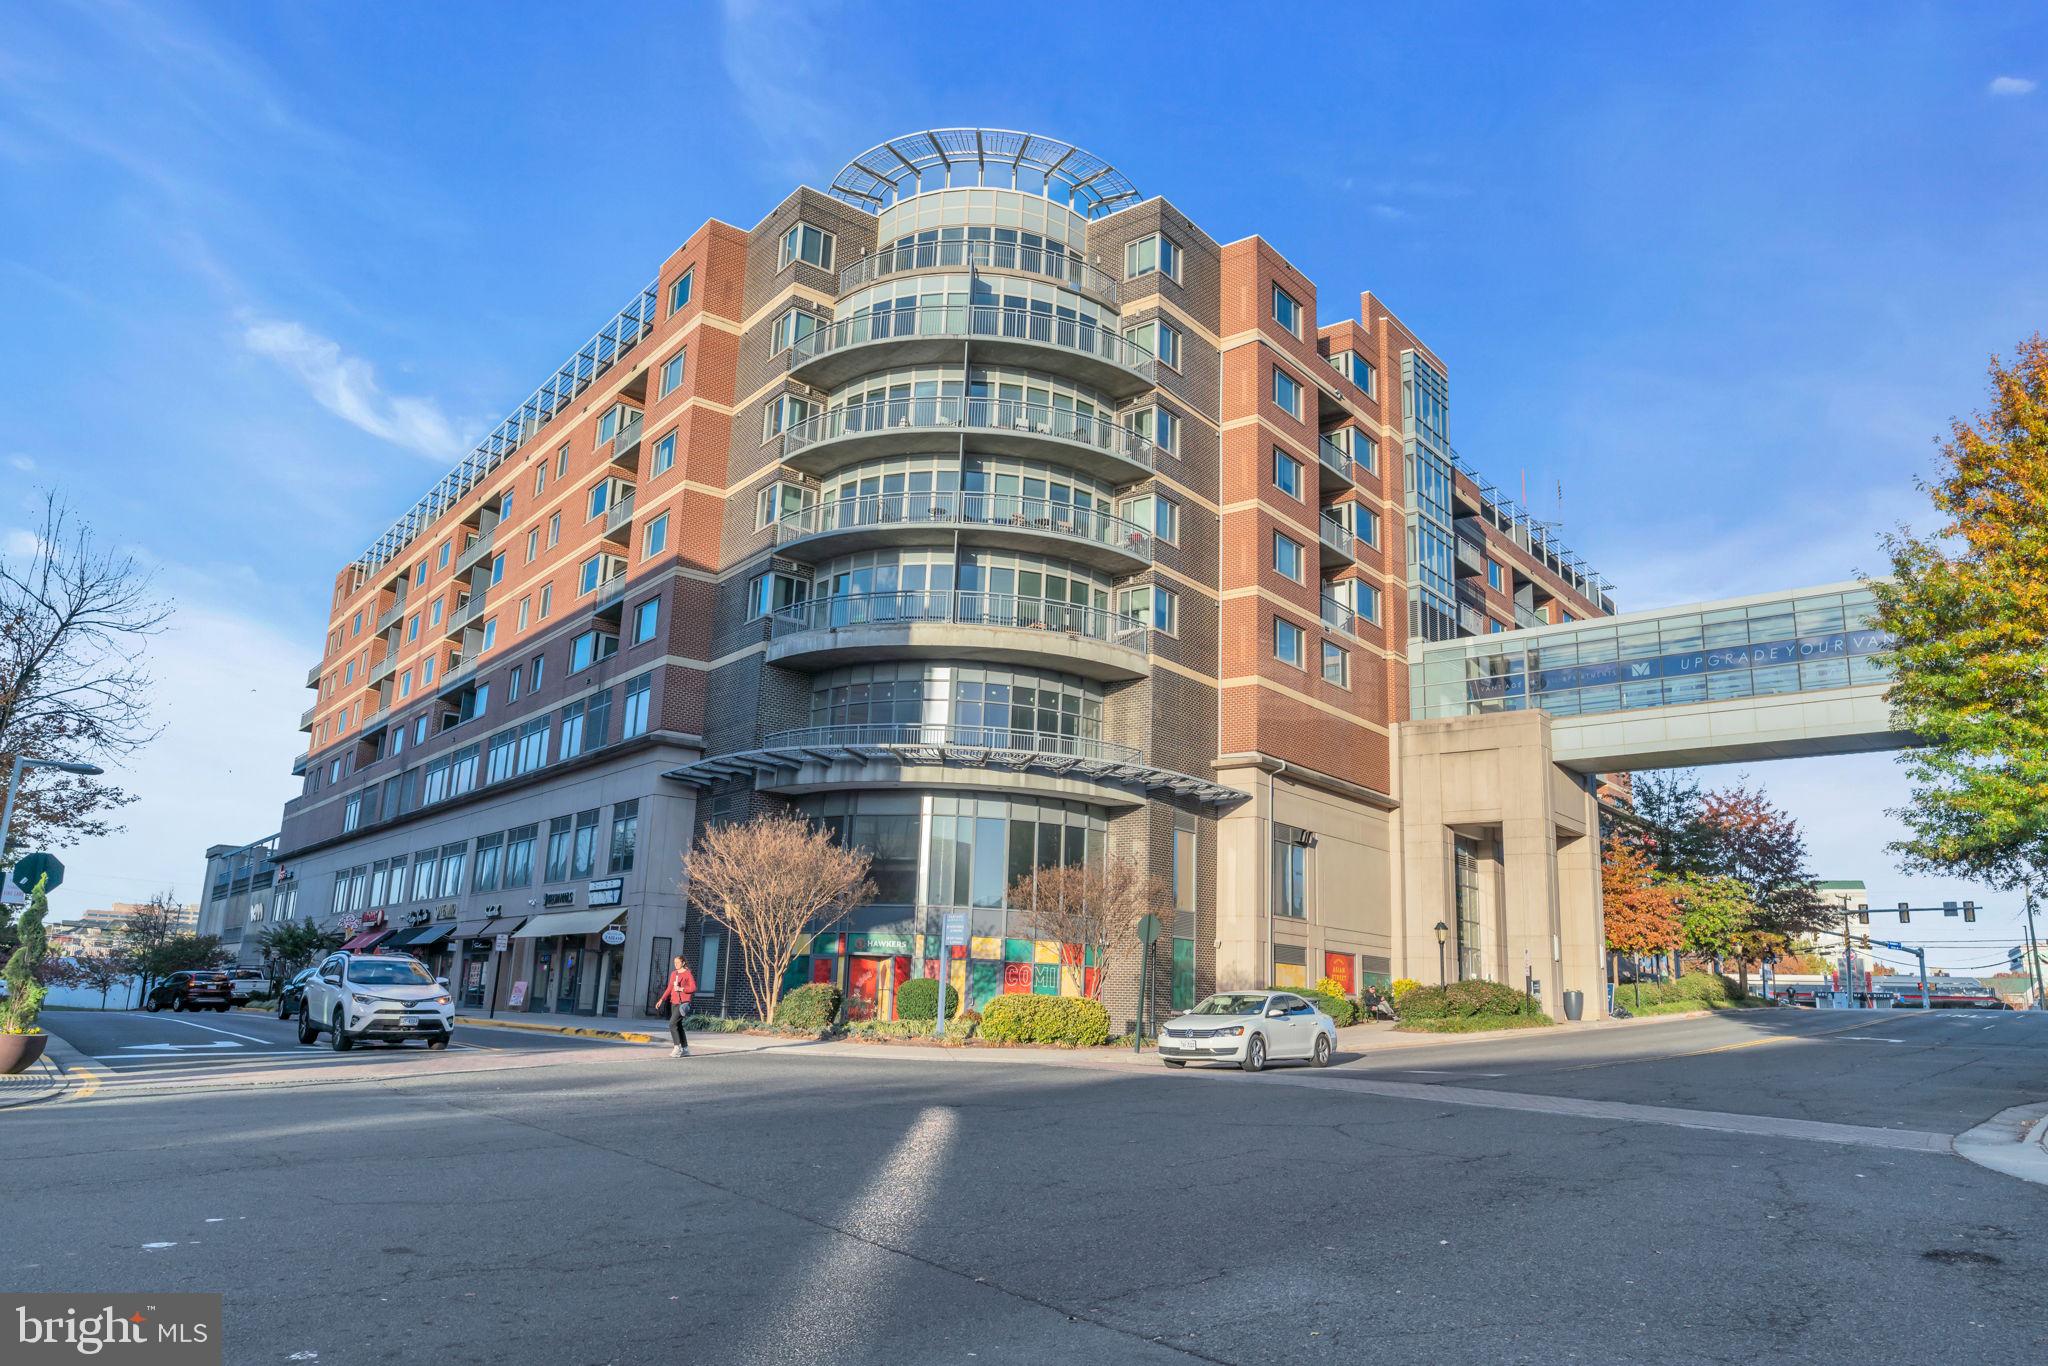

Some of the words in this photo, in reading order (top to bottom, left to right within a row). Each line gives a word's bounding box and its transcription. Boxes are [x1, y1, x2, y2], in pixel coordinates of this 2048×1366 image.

[1680, 647, 1779, 670] UPGRADE
[1786, 639, 1843, 657] YOUR
[867, 940, 907, 948] HAWKERS
